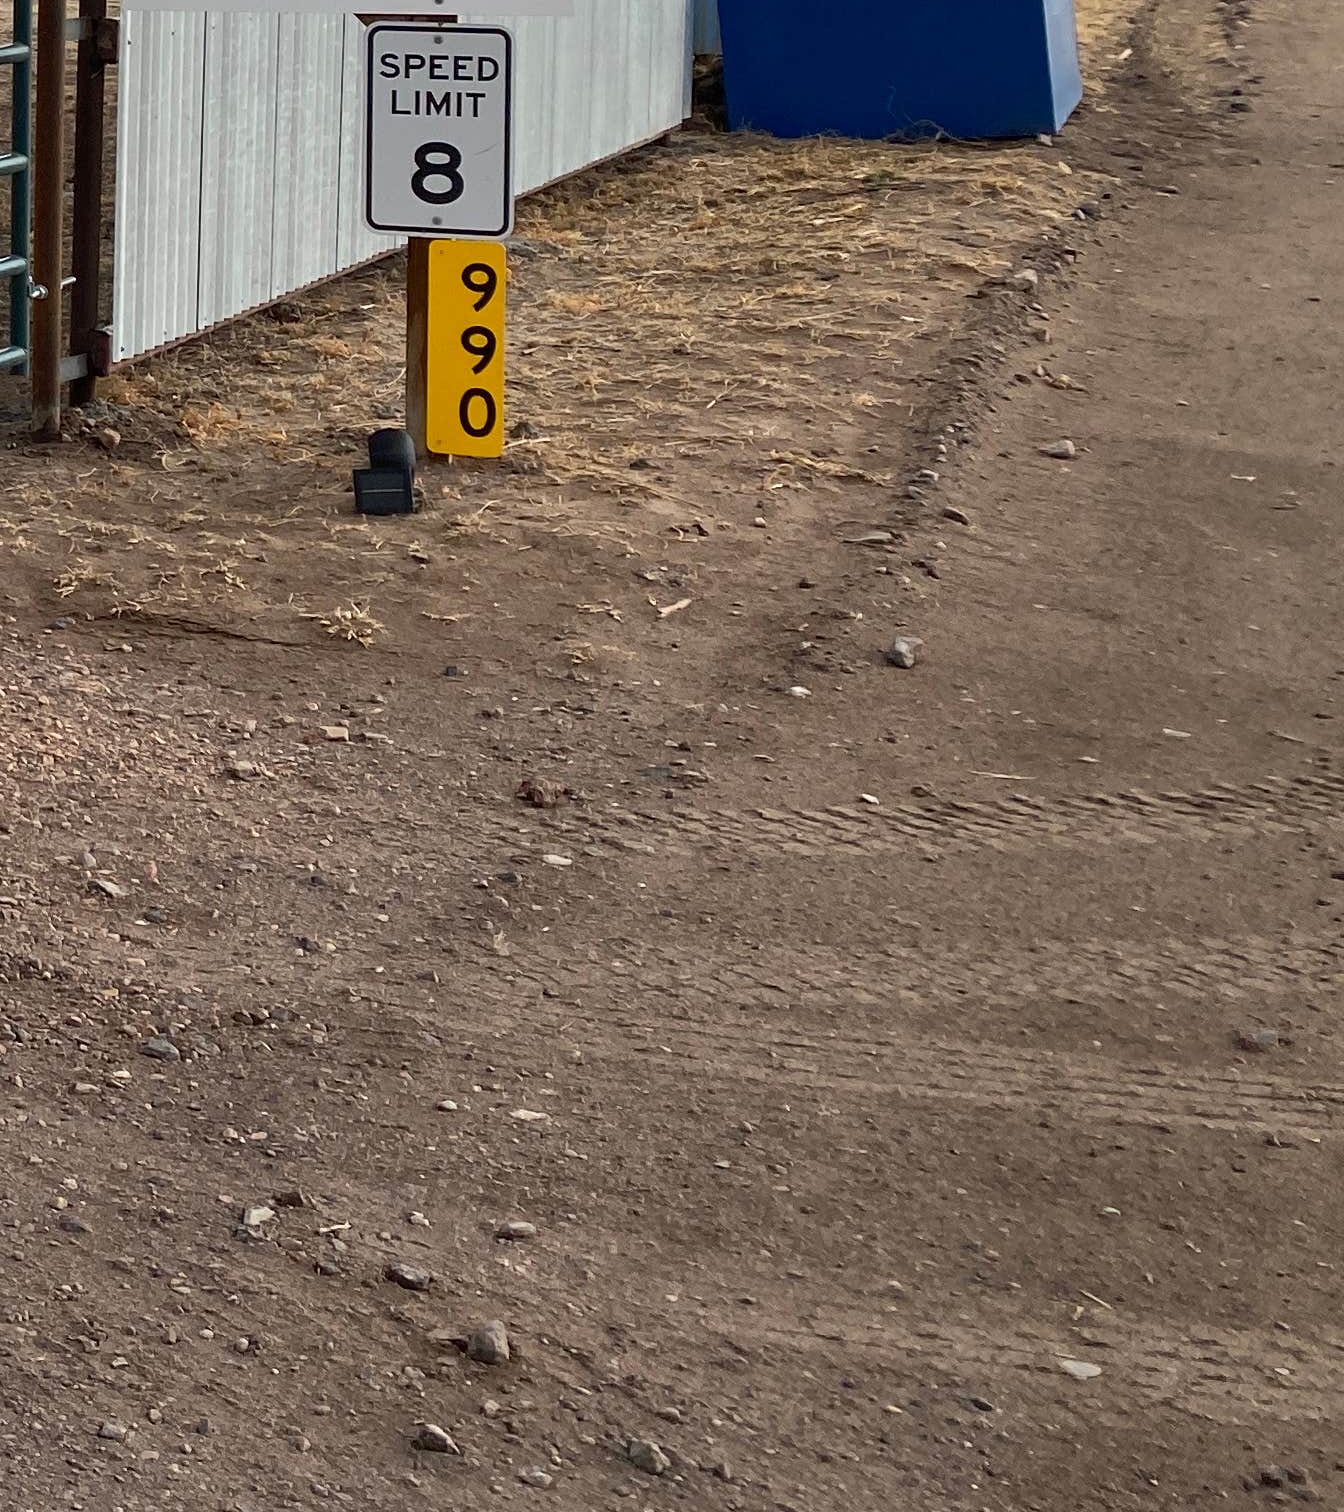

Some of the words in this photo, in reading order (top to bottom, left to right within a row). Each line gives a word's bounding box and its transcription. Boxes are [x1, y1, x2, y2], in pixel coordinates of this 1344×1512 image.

[380, 54, 499, 81] SPEED
[392, 90, 486, 117] LIMIT
[411, 142, 464, 204] 8
[459, 263, 497, 437] 990
